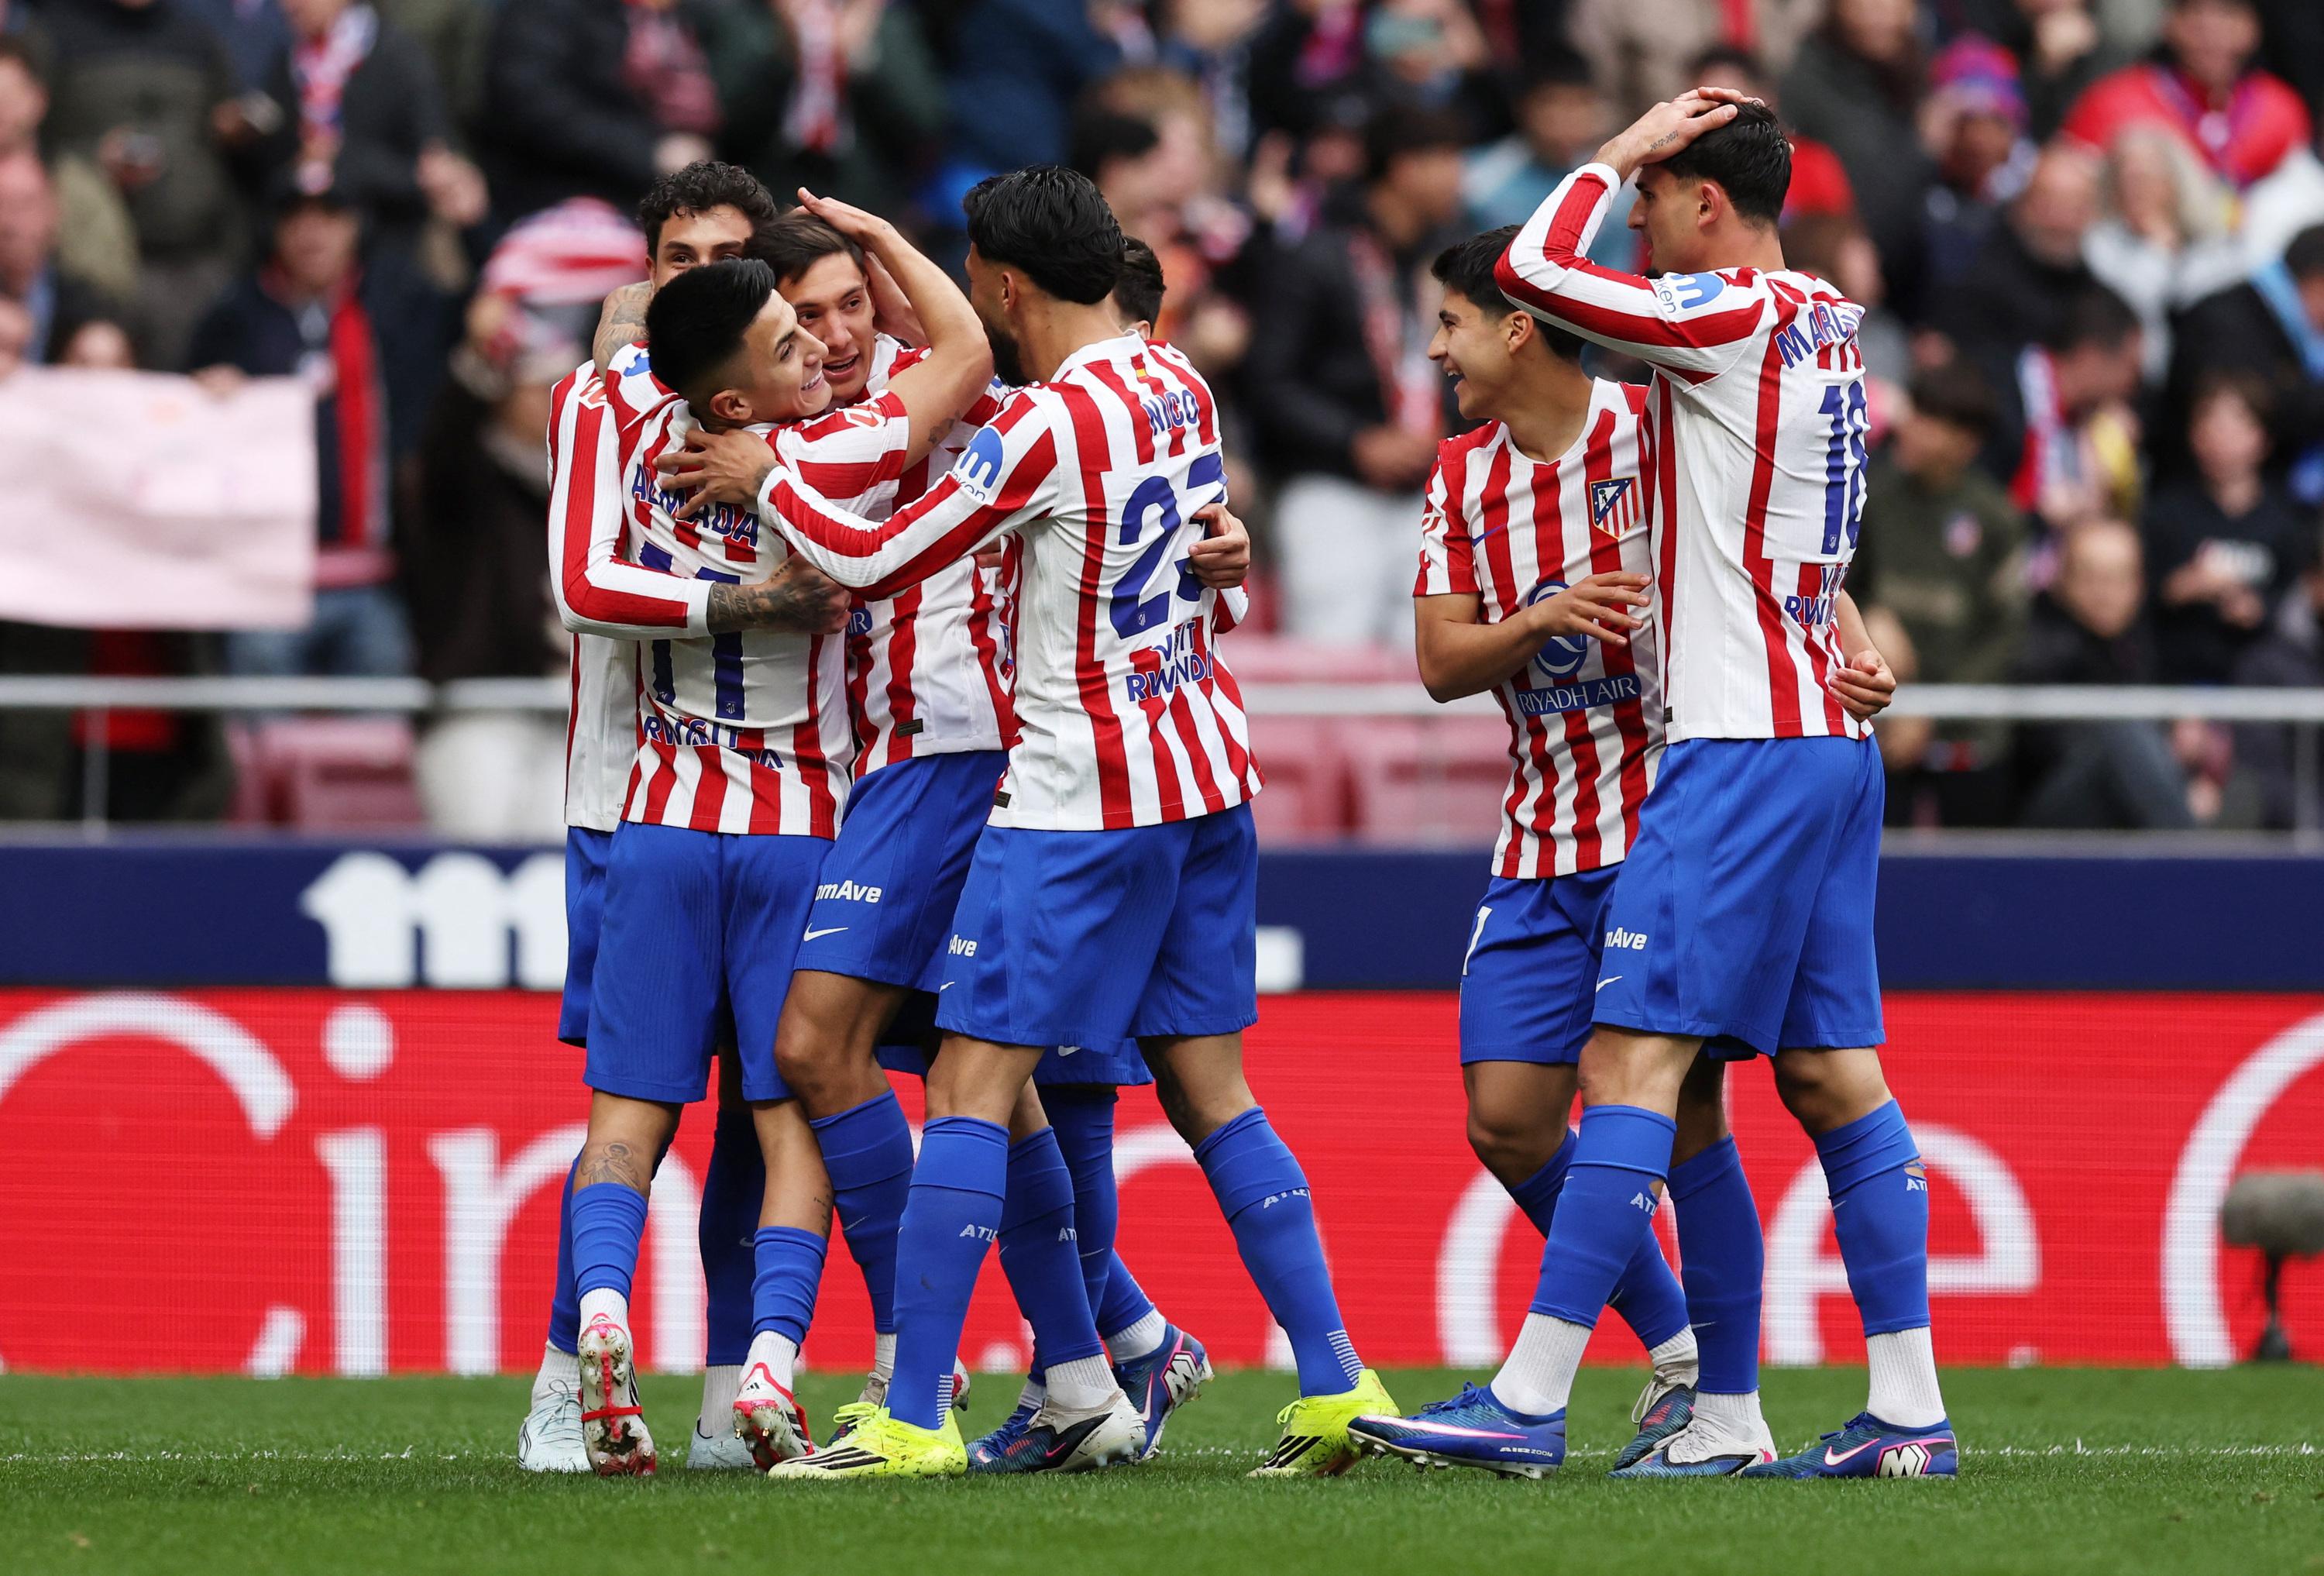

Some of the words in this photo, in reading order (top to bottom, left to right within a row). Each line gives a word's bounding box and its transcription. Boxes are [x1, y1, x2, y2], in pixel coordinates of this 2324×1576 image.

[1143, 390, 1199, 436] NICO
[1518, 686, 1589, 713] RIYADH
[1596, 677, 1637, 703] AIR
[947, 934, 978, 958] Ave
[1531, 1448, 1554, 1457] ZOOM
